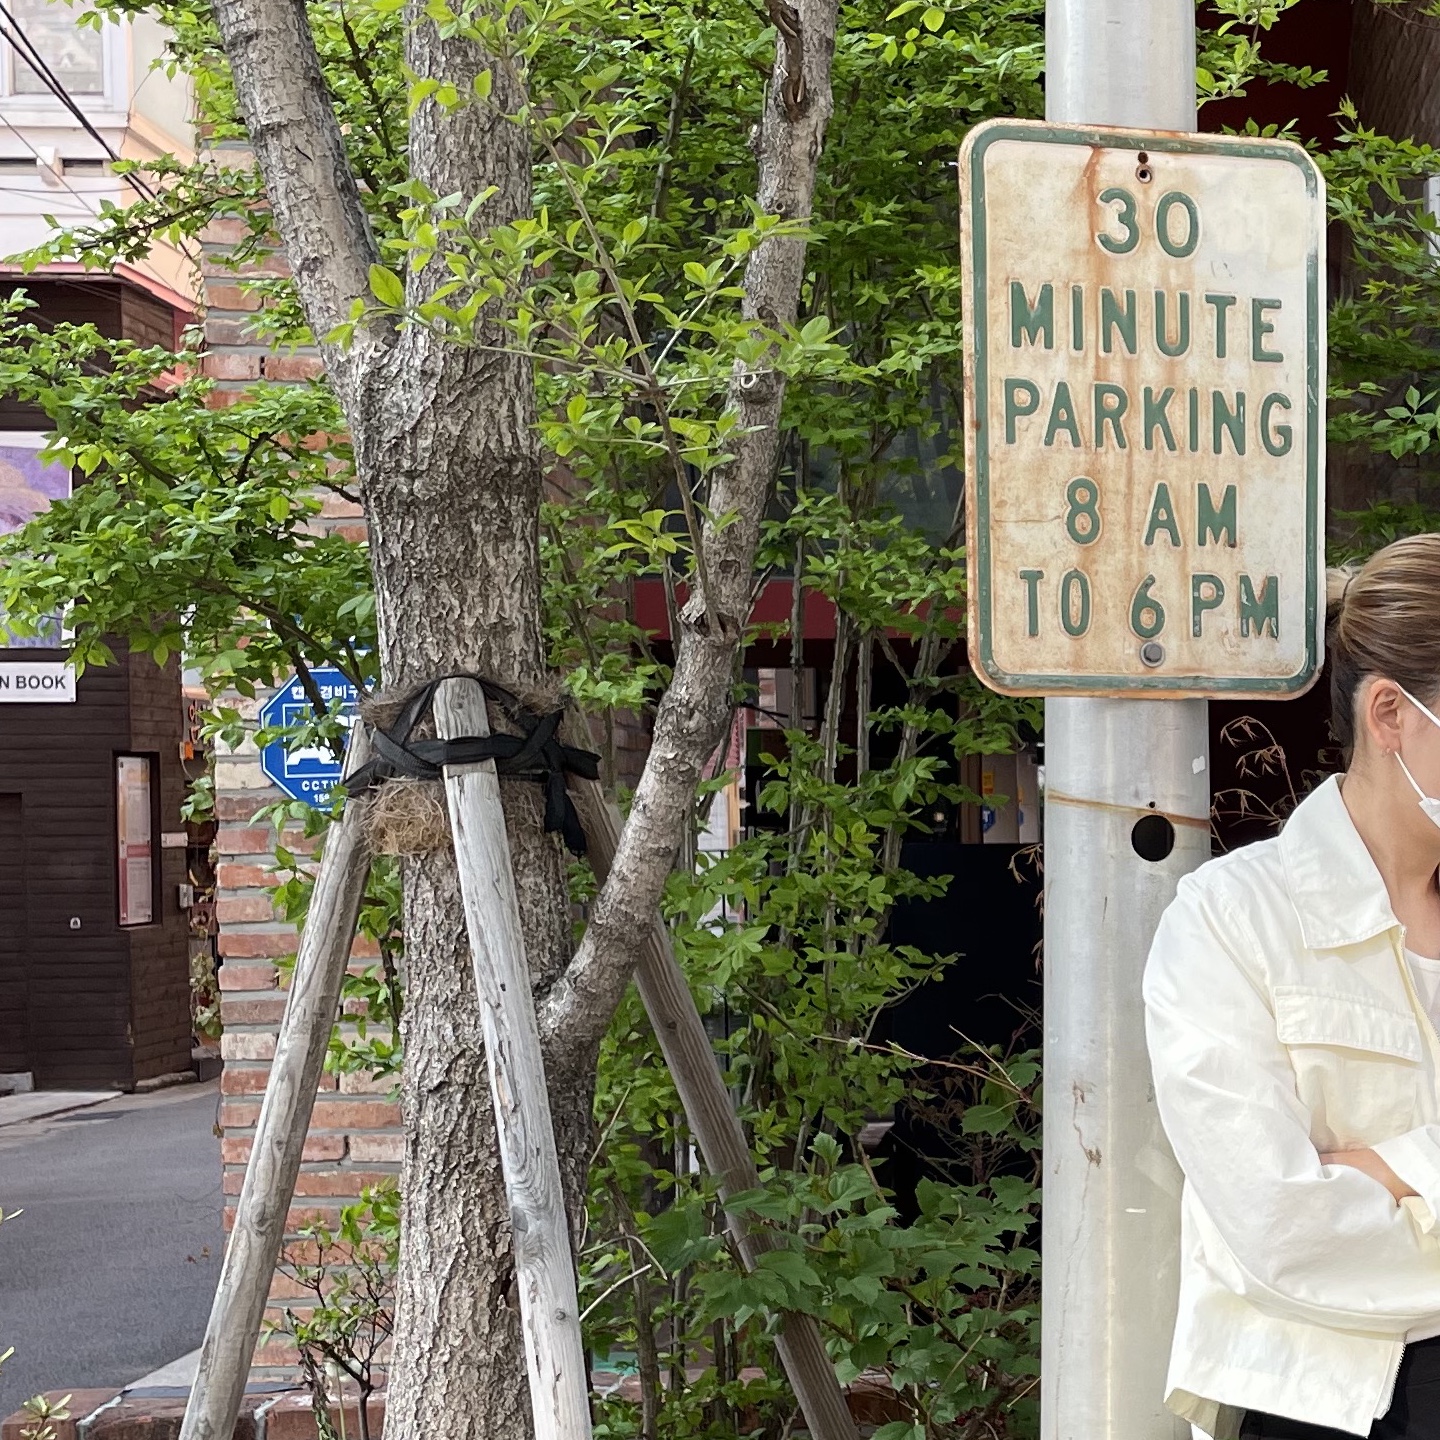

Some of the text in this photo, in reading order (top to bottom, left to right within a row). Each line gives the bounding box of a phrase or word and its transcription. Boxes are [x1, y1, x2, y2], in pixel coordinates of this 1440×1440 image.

[1097, 187, 1200, 258] 30
[1010, 281, 1285, 363] MINUTE
[1003, 378, 1294, 458] PARKING
[1066, 478, 1238, 549] 8 AM
[1019, 568, 1092, 638] TO
[15, 674, 67, 690] BOOK
